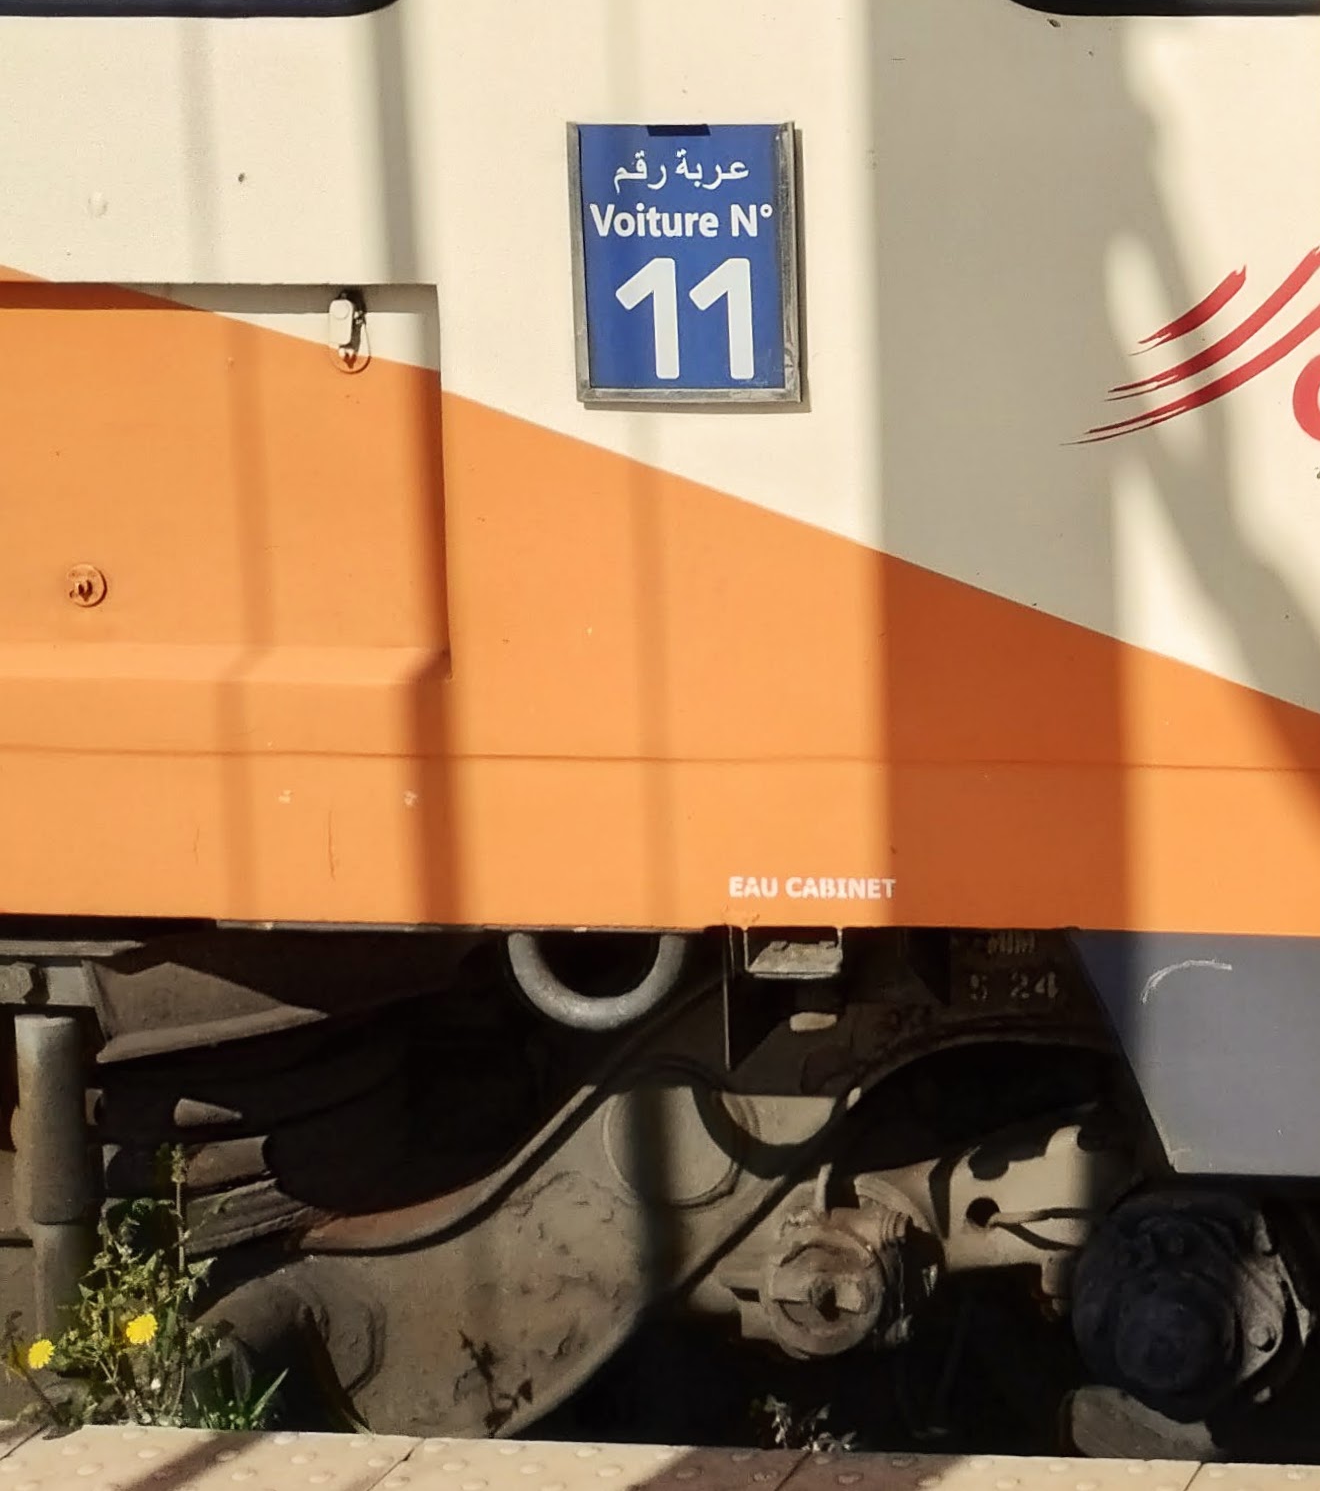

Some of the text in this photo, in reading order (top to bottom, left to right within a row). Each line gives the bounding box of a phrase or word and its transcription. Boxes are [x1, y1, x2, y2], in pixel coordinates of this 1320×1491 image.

[613, 149, 749, 193] عربة رقم
[590, 202, 773, 238] Voiture N°
[615, 257, 754, 380] 11
[729, 875, 896, 900] EAU CABINET
